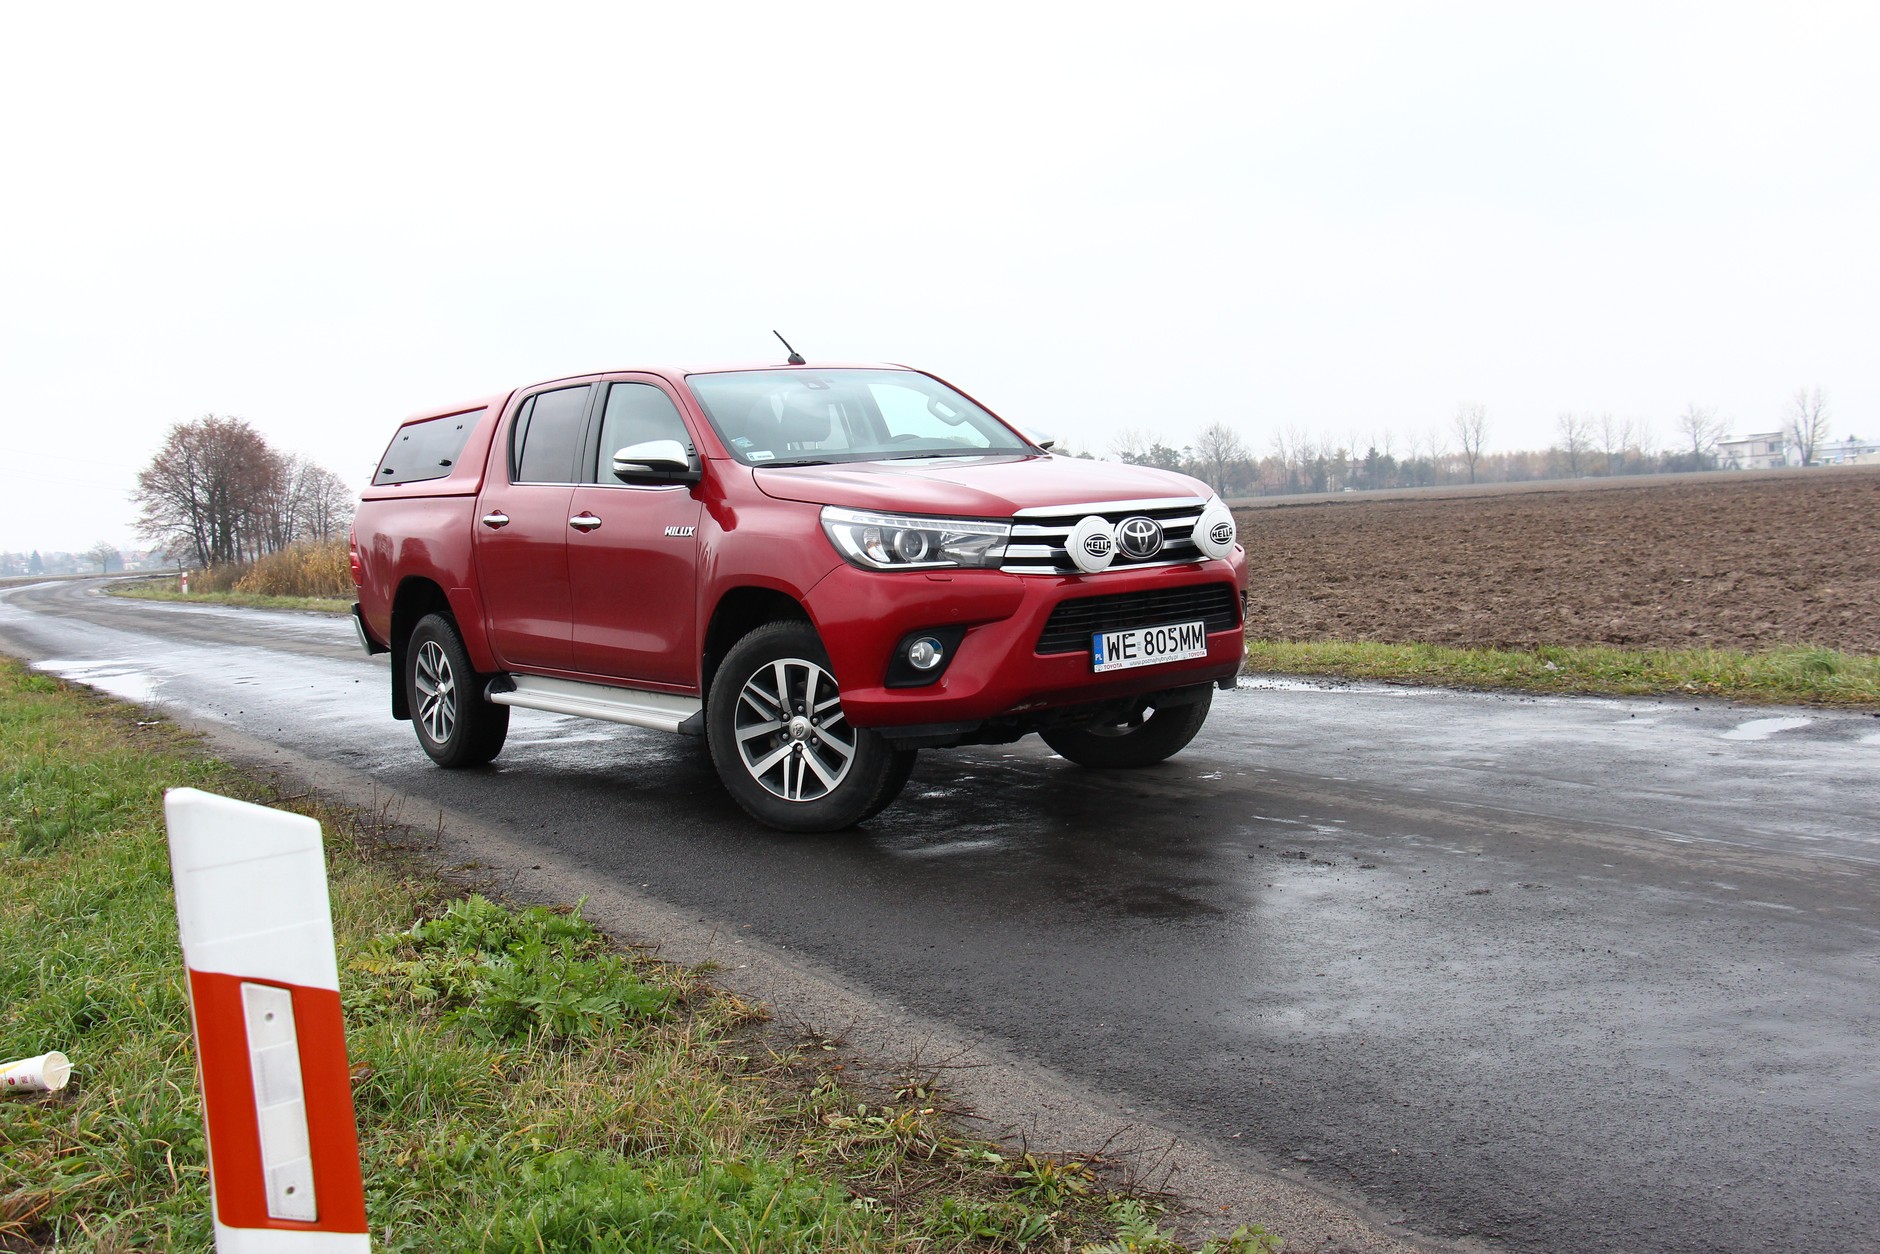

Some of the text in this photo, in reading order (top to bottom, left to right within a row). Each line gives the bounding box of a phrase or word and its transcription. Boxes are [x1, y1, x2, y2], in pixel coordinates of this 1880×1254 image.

[664, 526, 695, 537] HILUX
[1212, 527, 1232, 538] HELLA
[1086, 540, 1111, 551] HELLA
[1106, 623, 1204, 661] WE 805MM
[1095, 653, 1103, 661] PL
